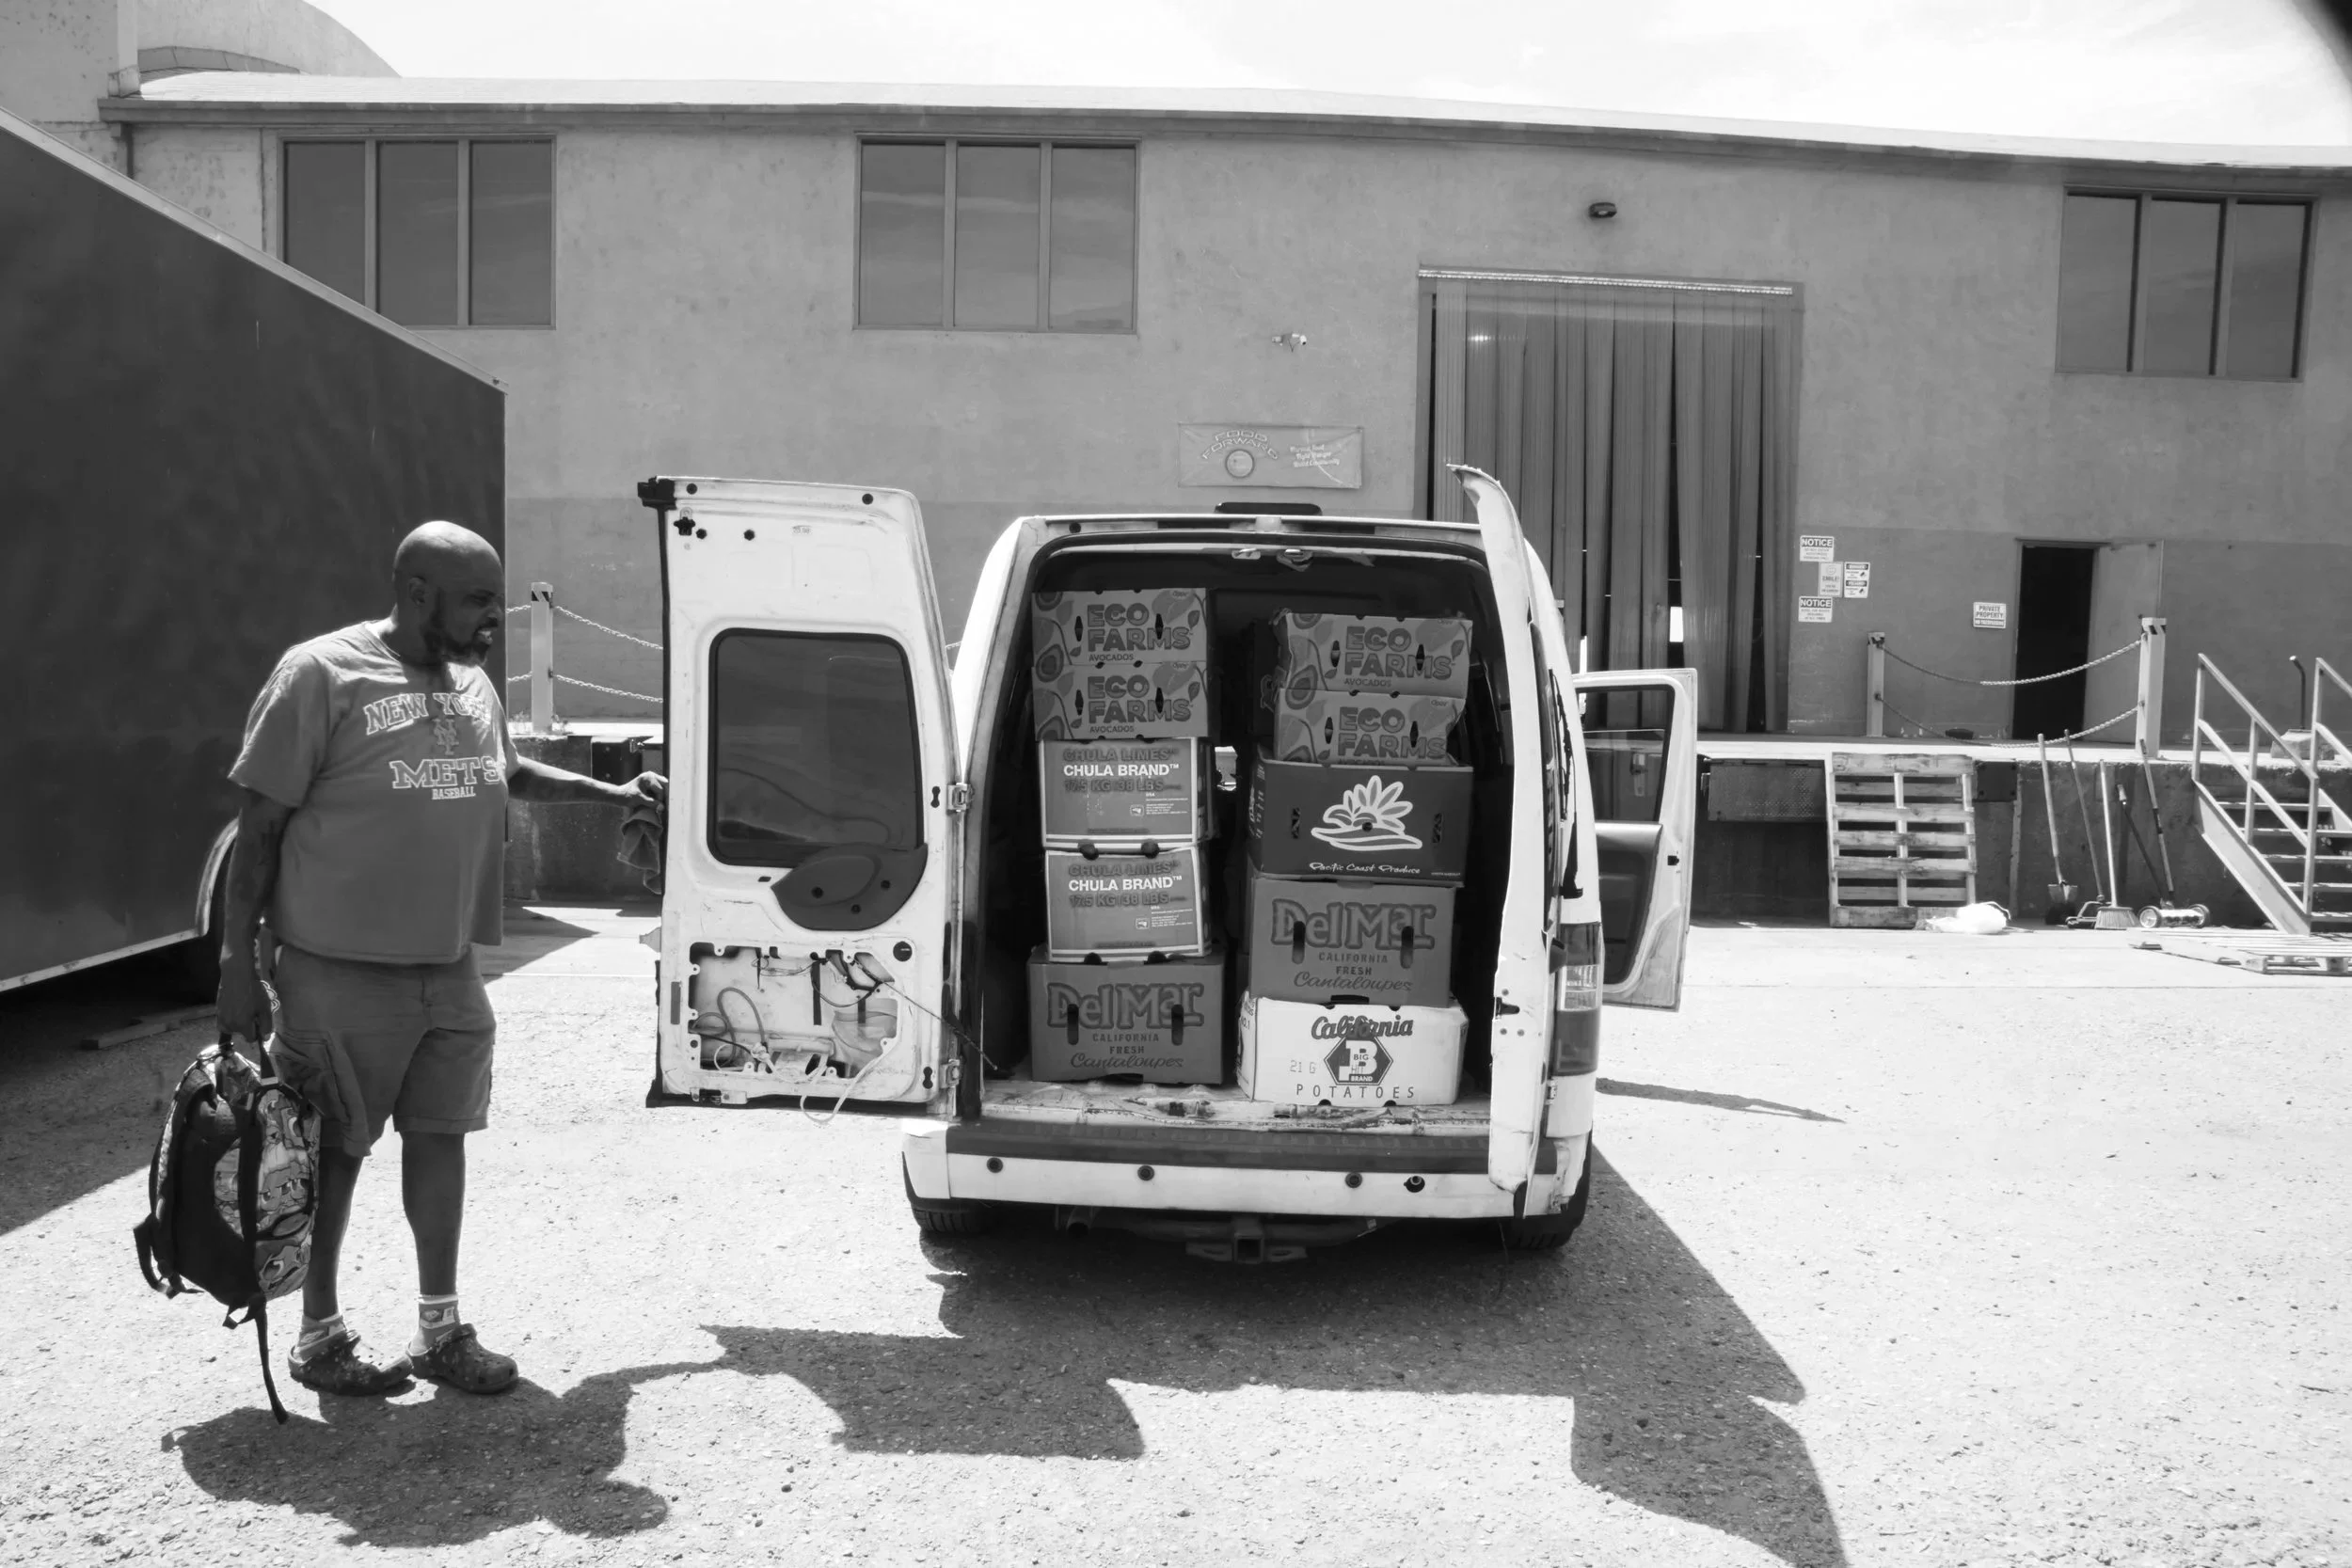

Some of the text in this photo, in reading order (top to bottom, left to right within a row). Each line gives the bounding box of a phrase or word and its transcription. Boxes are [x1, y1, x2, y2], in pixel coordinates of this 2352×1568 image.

[1215, 430, 1267, 442] FOOD
[1202, 437, 1279, 459] FORWARD
[1802, 538, 1833, 546] NOTICE
[1800, 599, 1832, 608] NOTICE
[1087, 603, 1150, 627] ECO
[1345, 626, 1412, 653] ECO
[1089, 653, 1135, 662] AVOCADOS
[1088, 674, 1150, 699] ECO
[1343, 678, 1391, 689] AVOCADOS
[363, 693, 429, 736] NEW
[1339, 706, 1406, 734] ECO
[1089, 725, 1135, 734] AVOCADOS
[1063, 748, 1118, 761] CHULA
[389, 755, 501, 789] METS
[1063, 765, 1114, 776] CHULA
[1091, 779, 1111, 792] KG
[432, 786, 476, 800] BASEBALL
[1069, 863, 1121, 877] CHULA
[1309, 862, 1344, 872] Pacific
[1346, 863, 1375, 873] Coast
[1378, 864, 1421, 874] Produce
[1069, 879, 1119, 891] CHULA
[1096, 894, 1116, 907] KG
[1318, 952, 1388, 963] CALIFORNIA
[1336, 966, 1373, 976] FRESH
[1294, 971, 1413, 991] Cantaloupes
[1311, 1015, 1413, 1039] California
[1092, 1034, 1159, 1042] CALIFORNIA
[1071, 1053, 1184, 1069] Cantaloupes
[1295, 1084, 1415, 1099] POTATOES
